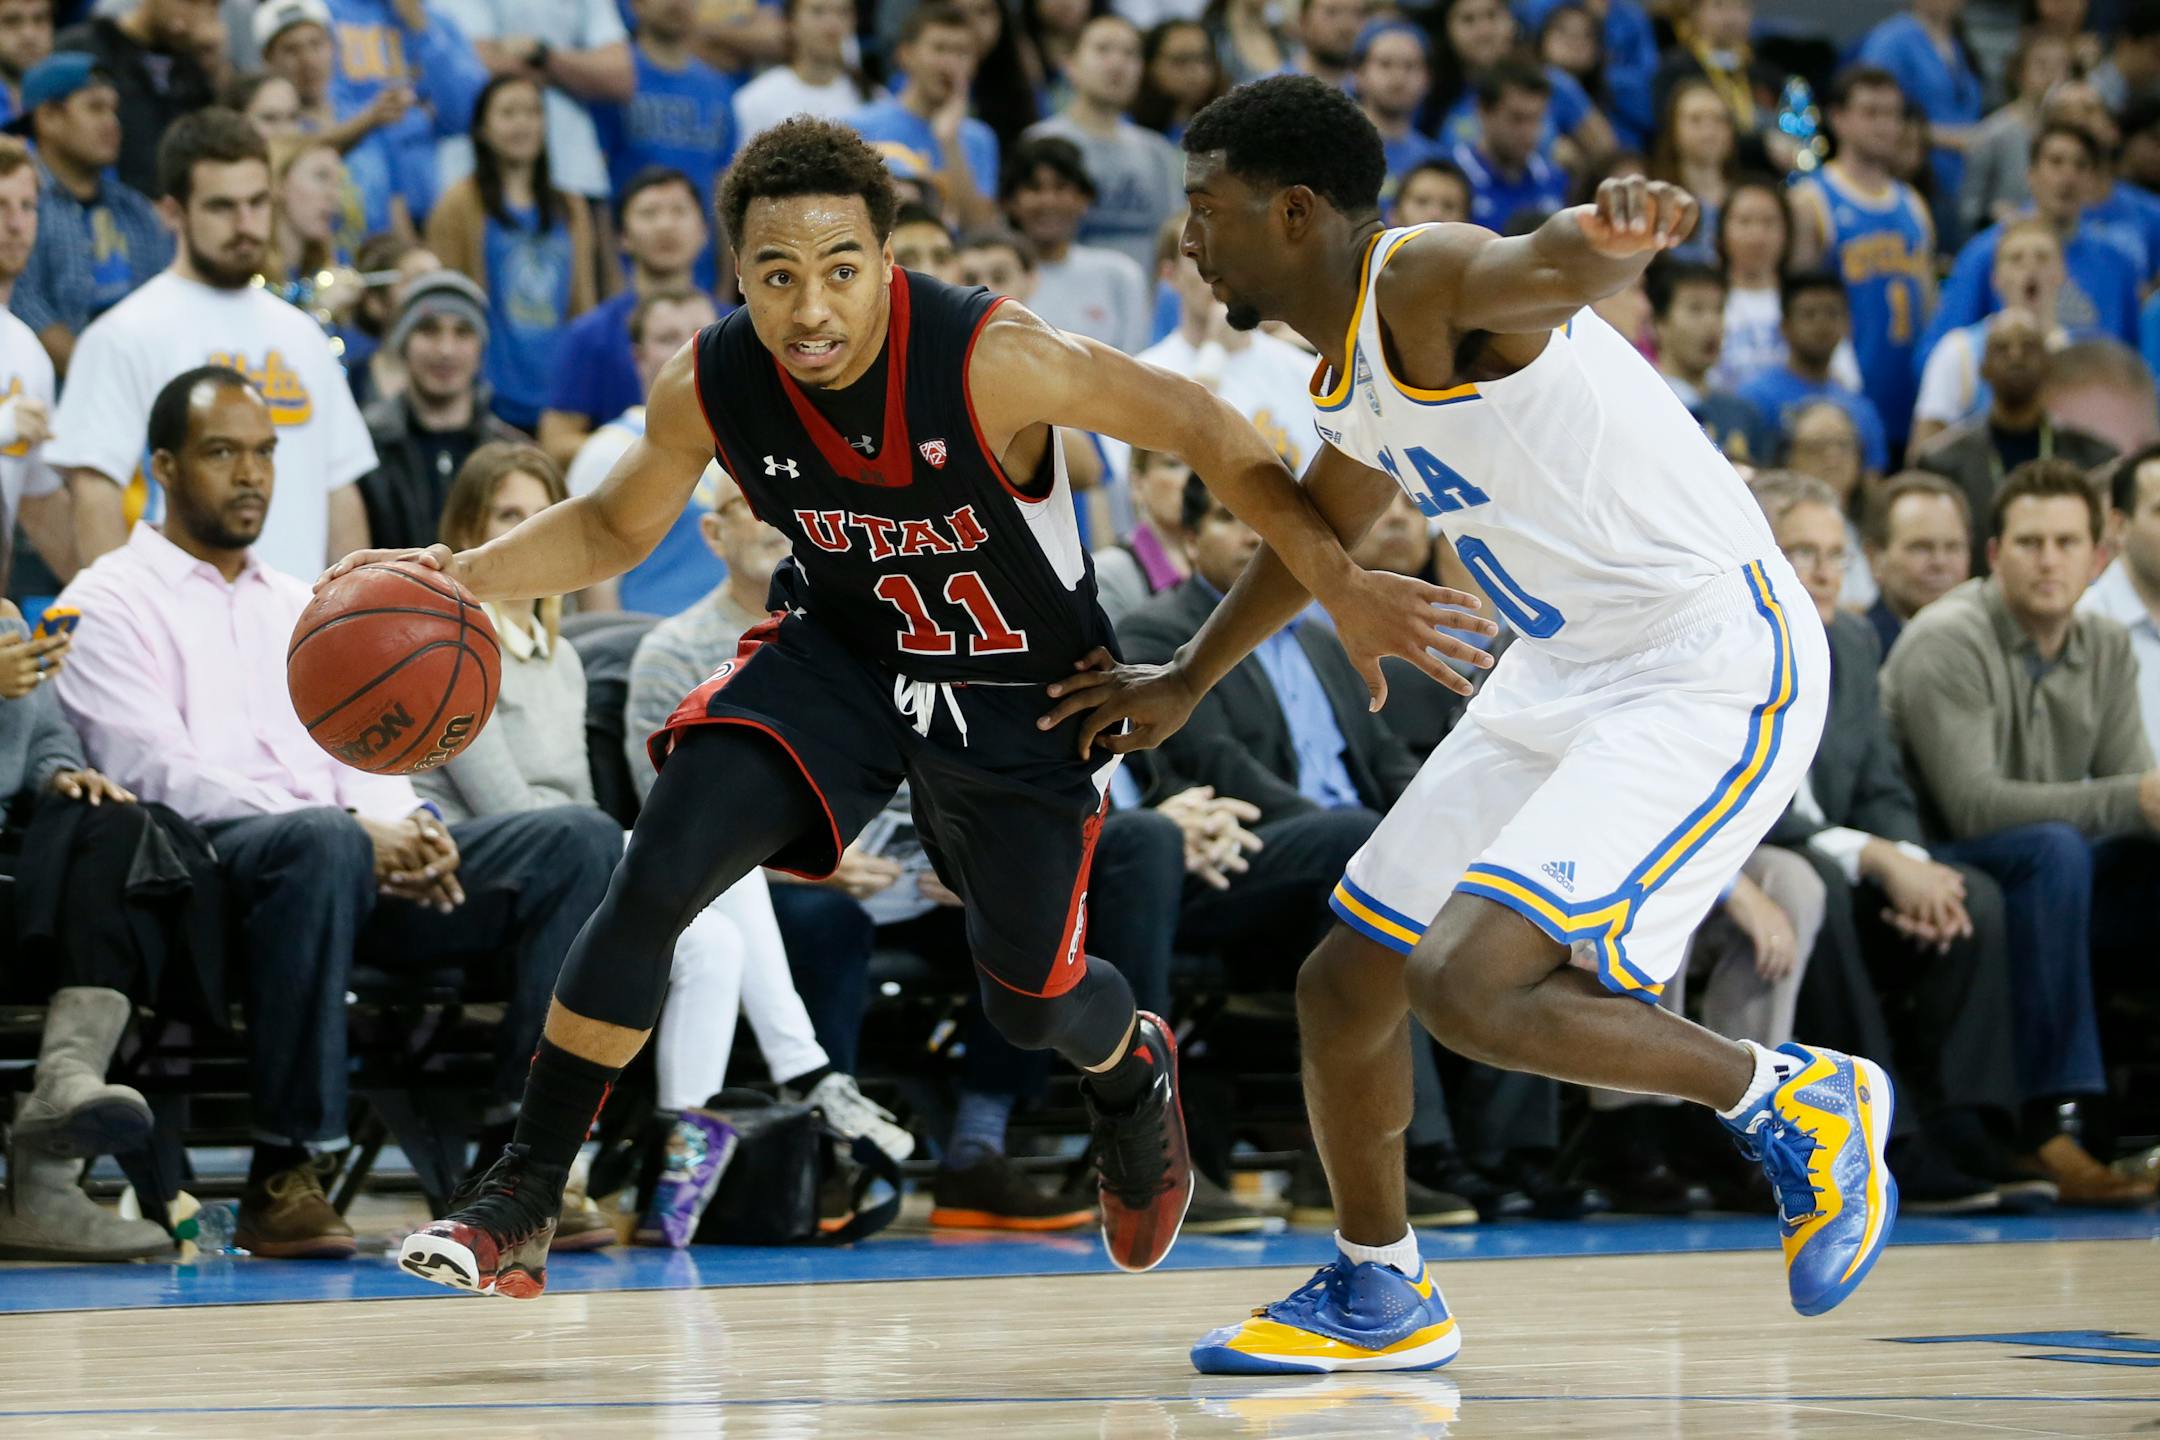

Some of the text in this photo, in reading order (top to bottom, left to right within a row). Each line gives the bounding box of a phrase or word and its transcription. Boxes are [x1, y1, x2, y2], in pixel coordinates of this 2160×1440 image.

[873, 571, 1029, 656] 11
[1455, 534, 1566, 638] 0
[1541, 863, 1575, 893] adidas
